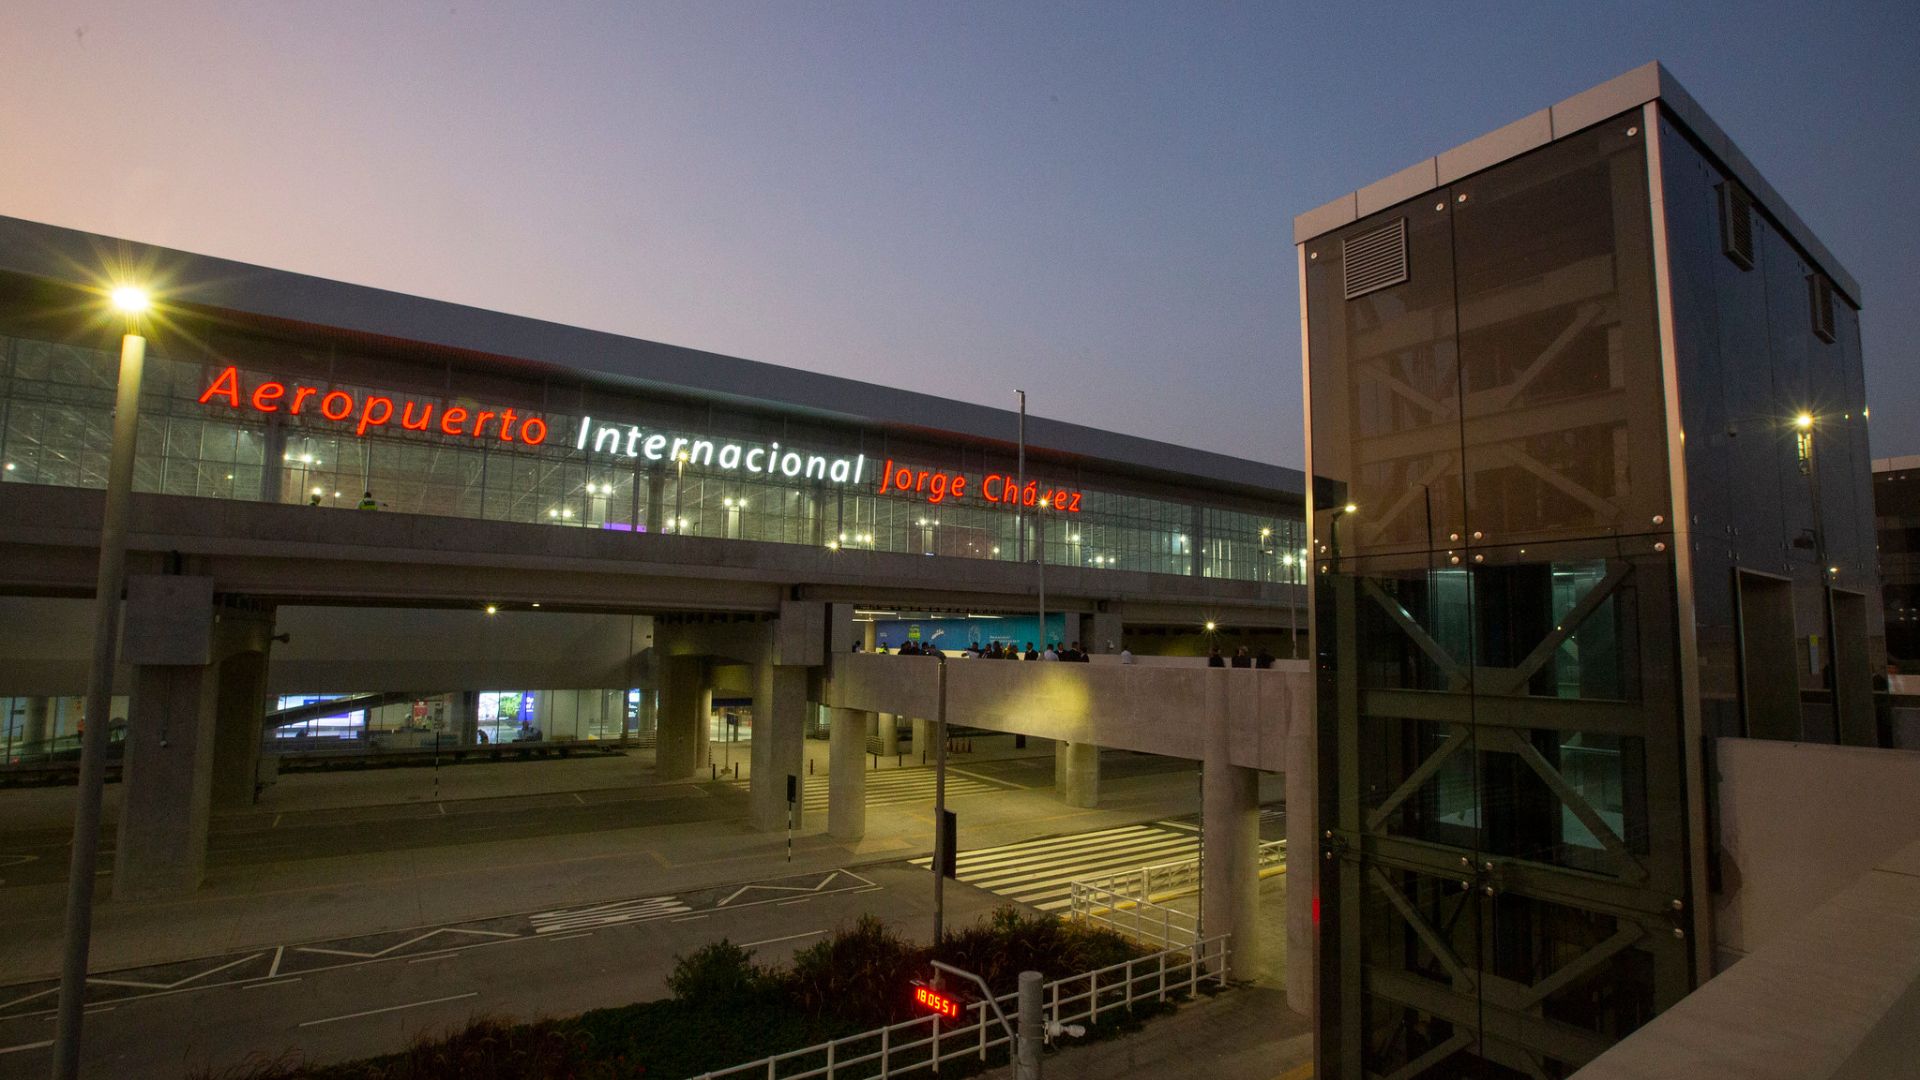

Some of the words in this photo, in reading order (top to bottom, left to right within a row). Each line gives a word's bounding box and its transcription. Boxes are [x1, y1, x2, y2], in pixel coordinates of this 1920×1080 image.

[199, 365, 547, 445] Aeropuerto
[577, 416, 864, 484] Internacional
[879, 459, 966, 503] Jorge
[528, 896, 693, 934] BUS
